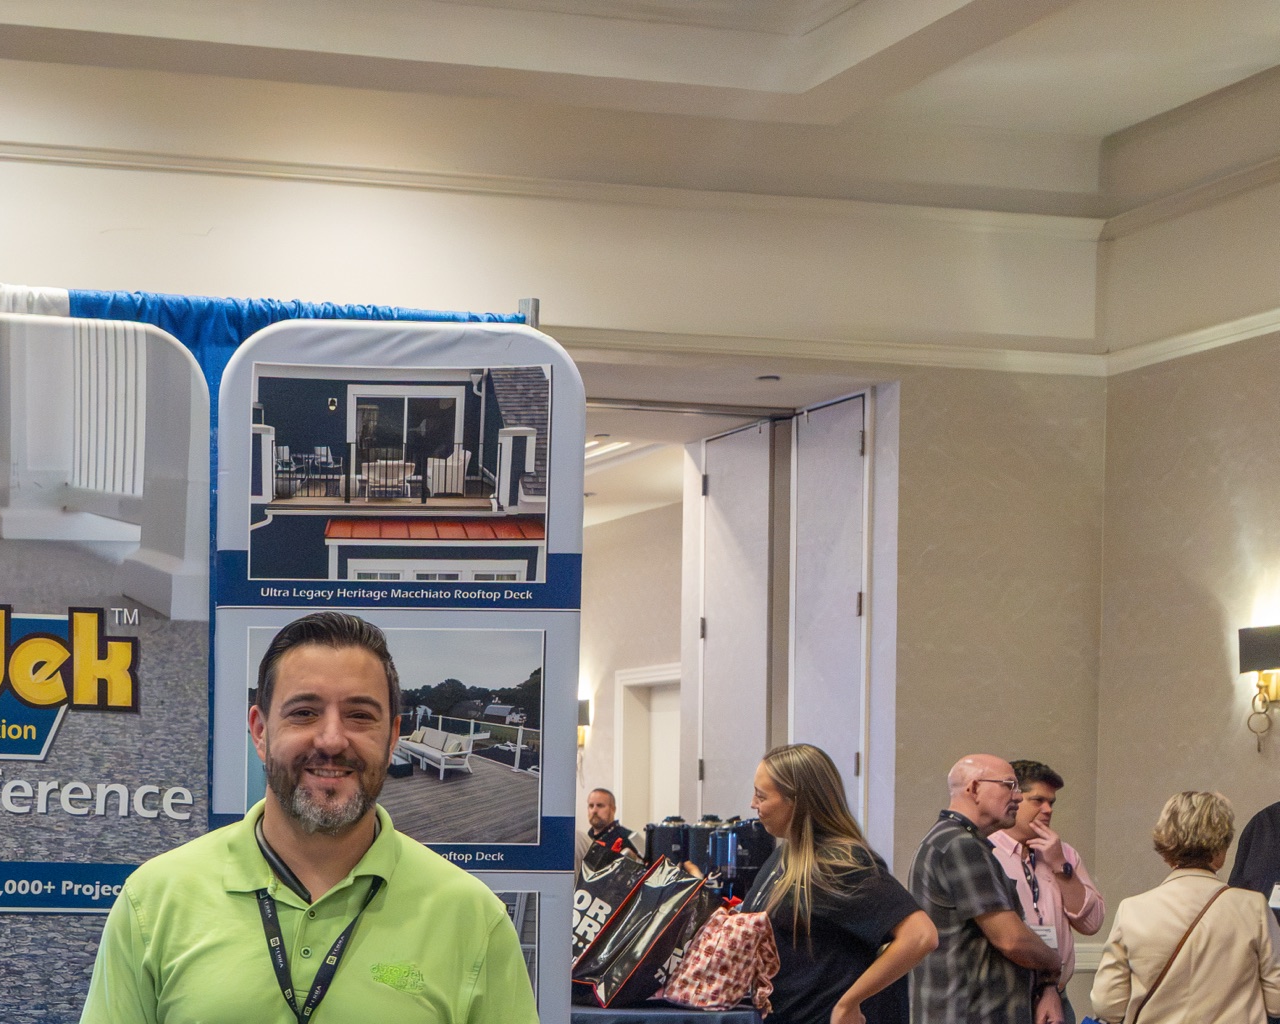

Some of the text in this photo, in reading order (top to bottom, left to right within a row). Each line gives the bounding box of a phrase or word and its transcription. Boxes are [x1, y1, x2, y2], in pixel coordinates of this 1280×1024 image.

[260, 587, 533, 601] Ultra Legacy Heritage Macchiato Rooftop Deck
[111, 607, 139, 625] TM
[441, 851, 504, 863] oftop Deck
[61, 880, 122, 900] Projec
